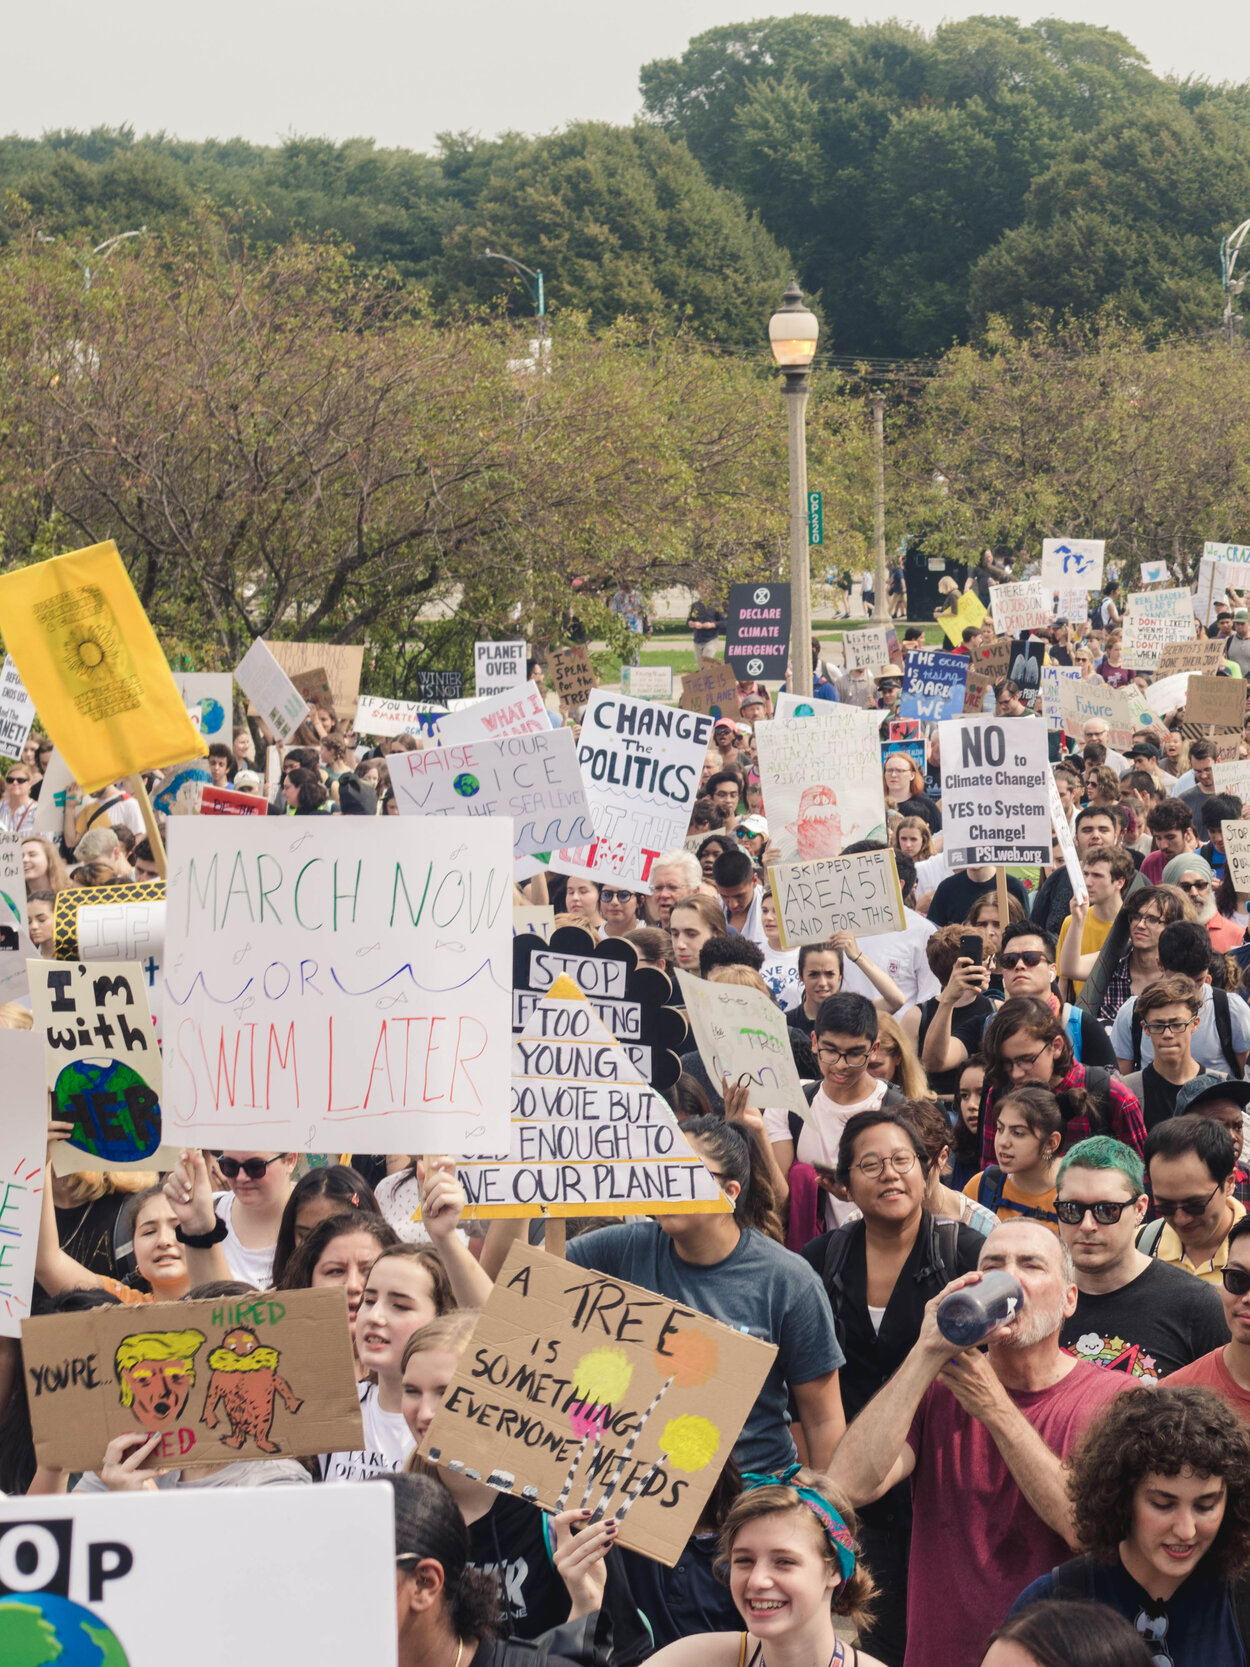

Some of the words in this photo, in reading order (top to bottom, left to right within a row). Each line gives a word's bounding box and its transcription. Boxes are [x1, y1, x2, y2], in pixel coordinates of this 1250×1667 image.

[810, 494, 820, 543] CP220
[993, 585, 1026, 598] THERE
[1027, 581, 1043, 596] ARE
[739, 608, 781, 620] DECLARE
[996, 601, 1010, 614] NO
[1010, 599, 1030, 611] JOBS
[1030, 597, 1042, 610] ON
[738, 626, 779, 638] CLIMATE
[1005, 614, 1027, 631] DEAD
[728, 644, 786, 656] EMERGENCY
[846, 632, 879, 645] Listen
[478, 644, 524, 660] PLANET
[908, 651, 935, 664] THE
[939, 655, 969, 672] ocean
[419, 671, 463, 685] WINTER
[486, 661, 517, 676] OVER
[556, 663, 589, 680] SPEAK
[908, 668, 918, 679] IS
[922, 667, 963, 684] rising
[420, 684, 434, 698] IS
[435, 684, 462, 698] NOT
[559, 678, 574, 693] for
[908, 678, 923, 693] SO
[360, 696, 374, 708] IF
[379, 699, 402, 713] YOU
[406, 702, 435, 714] WERE
[917, 697, 945, 720] WE
[1075, 694, 1113, 717] Future
[594, 701, 712, 746] CHANGE
[407, 745, 480, 778] RAISE
[495, 735, 549, 759] YOUR
[622, 738, 653, 754] The
[961, 725, 1006, 768] NO
[1014, 754, 1027, 767] to
[579, 745, 697, 803] POLITICS
[945, 773, 992, 789] Climate
[995, 771, 1046, 788] Change!
[508, 794, 546, 818] SEA
[948, 802, 974, 819] YES
[978, 803, 992, 816] to
[995, 800, 1045, 819] System
[969, 824, 1026, 842] Change!
[1226, 825, 1249, 842] STOP
[975, 846, 1042, 864] PSLweb.org
[1232, 857, 1250, 870] OUR
[790, 859, 852, 881] SKIPPED
[856, 853, 885, 869] THE
[185, 850, 362, 938] MARCH
[389, 858, 510, 936] NOW
[784, 875, 857, 915] AREA
[858, 868, 888, 900] 51
[785, 917, 823, 938] RAID
[831, 911, 861, 931] FOR
[862, 905, 894, 925] THIS
[533, 954, 622, 989] STOP
[46, 962, 135, 1013] I'm
[46, 1013, 148, 1053] with
[538, 1006, 590, 1037] TOO
[173, 1015, 301, 1122] SWIM
[327, 1014, 490, 1114] LATER
[517, 1042, 618, 1082] YOUNG
[50, 1084, 163, 1143] HER
[541, 1086, 600, 1121] VOTE
[608, 1089, 656, 1124] BUT
[519, 1123, 632, 1162] ENOUGH
[635, 1124, 675, 1158] TO
[512, 1165, 587, 1203] OUR
[594, 1165, 706, 1201] PLANET
[211, 1299, 286, 1328] HIRED
[506, 1266, 531, 1297] A
[564, 1278, 696, 1356] TREE
[470, 1347, 641, 1438] SOMETHING
[444, 1386, 589, 1463] EVERYONE
[584, 1442, 692, 1509] NEEDS
